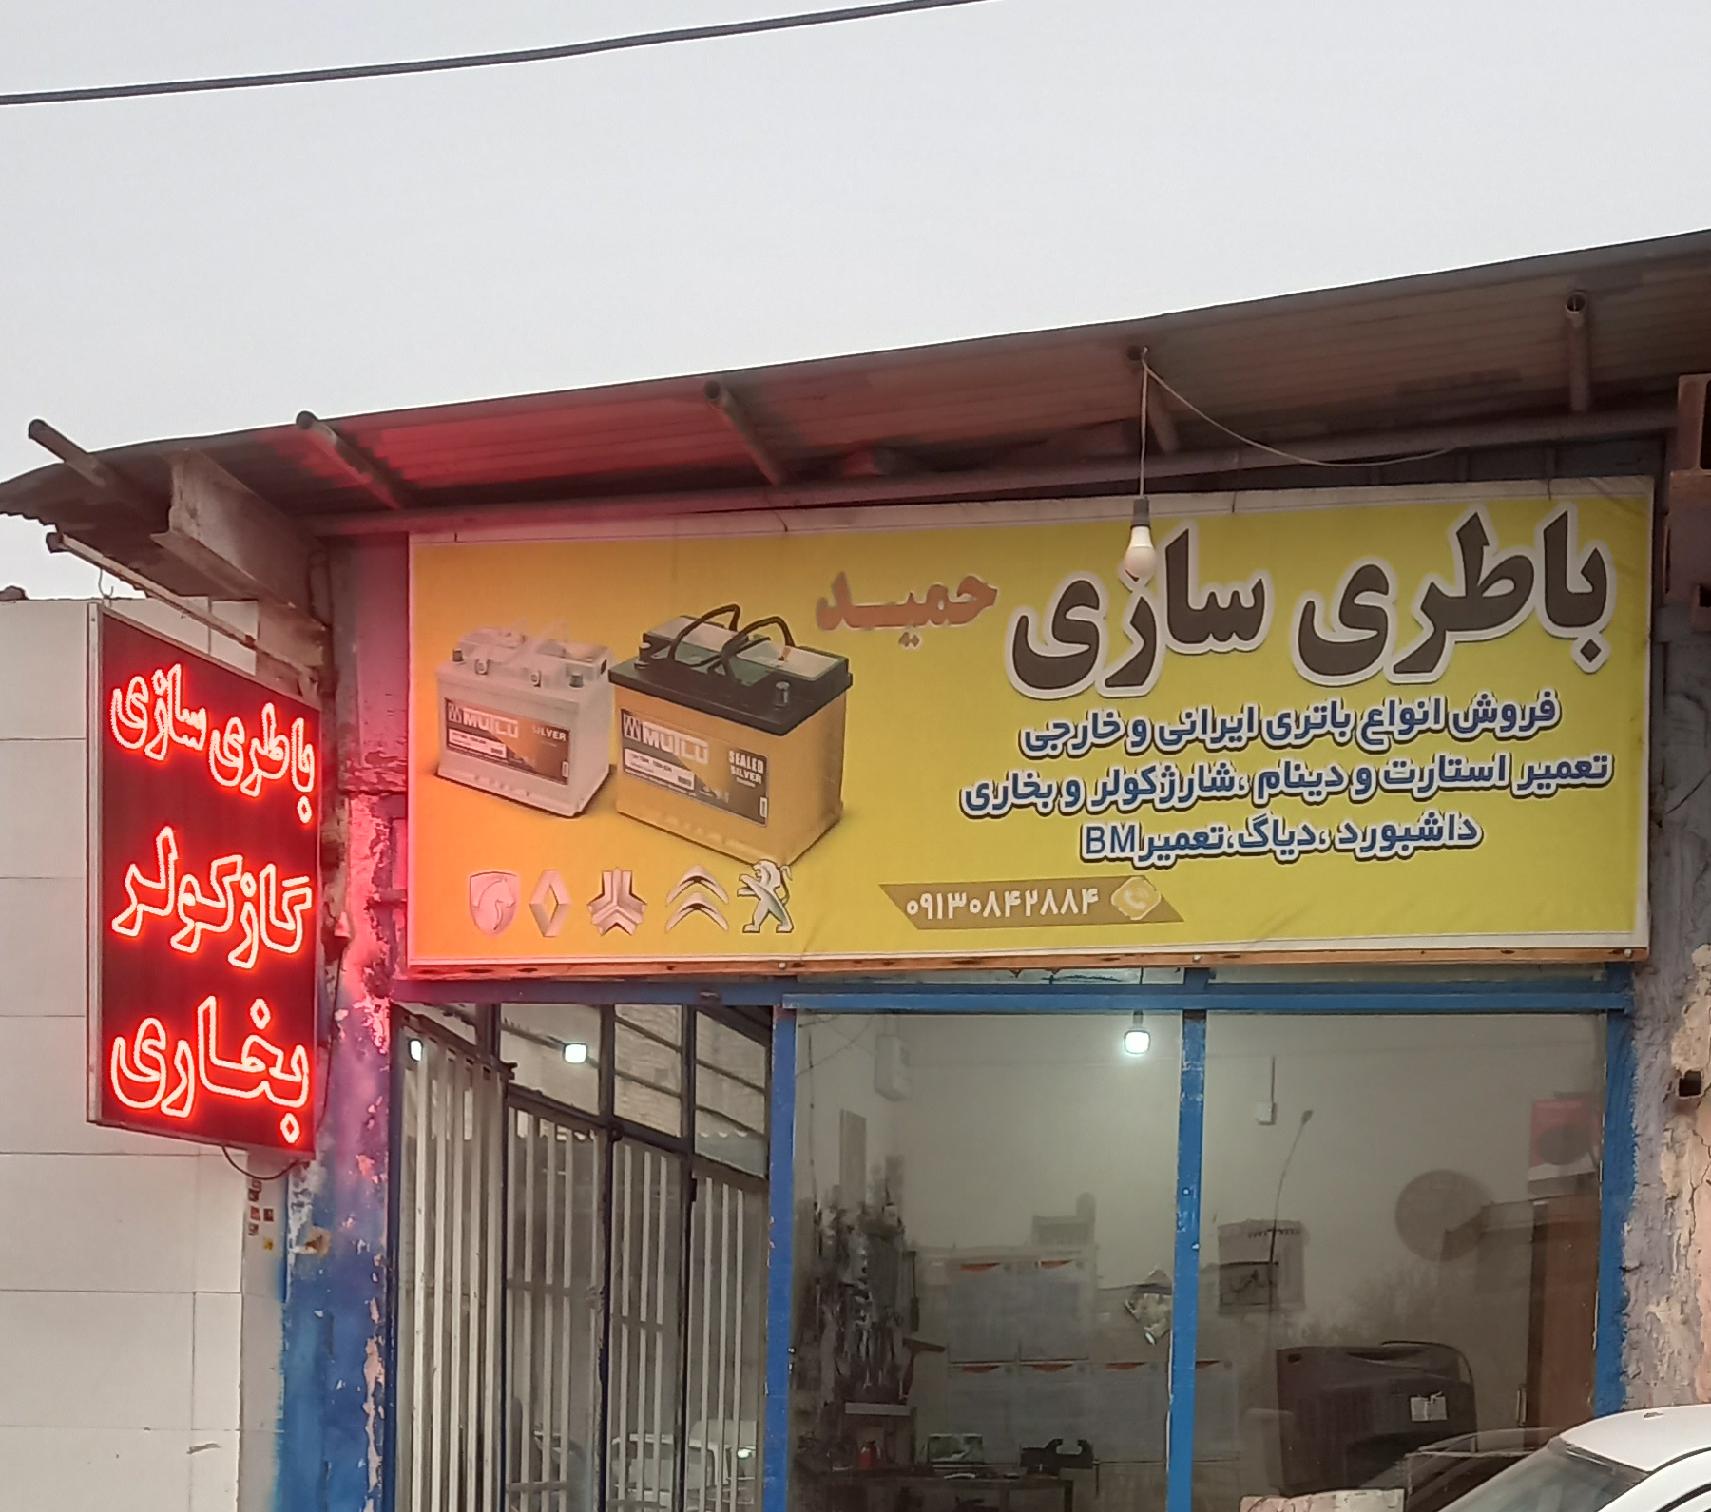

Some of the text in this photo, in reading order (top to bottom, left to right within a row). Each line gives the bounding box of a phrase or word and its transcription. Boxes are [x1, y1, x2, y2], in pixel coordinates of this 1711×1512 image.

[816, 509, 1609, 692] باطری سازی حمید
[109, 662, 317, 824] باطری سازی
[1022, 689, 1560, 754] فروش انواع باتری ایرانی و خارجی
[963, 770, 1055, 813] بخاری
[1063, 776, 1084, 810] و
[1353, 765, 1377, 797] و
[1382, 752, 1508, 795] استارت
[1515, 753, 1610, 793] تعمیر
[1337, 810, 1481, 854] داشبورد
[905, 887, 1100, 920] ۰۹۱۳۰۸۴۲۸۸۴
[110, 995, 311, 1145] بخاری
